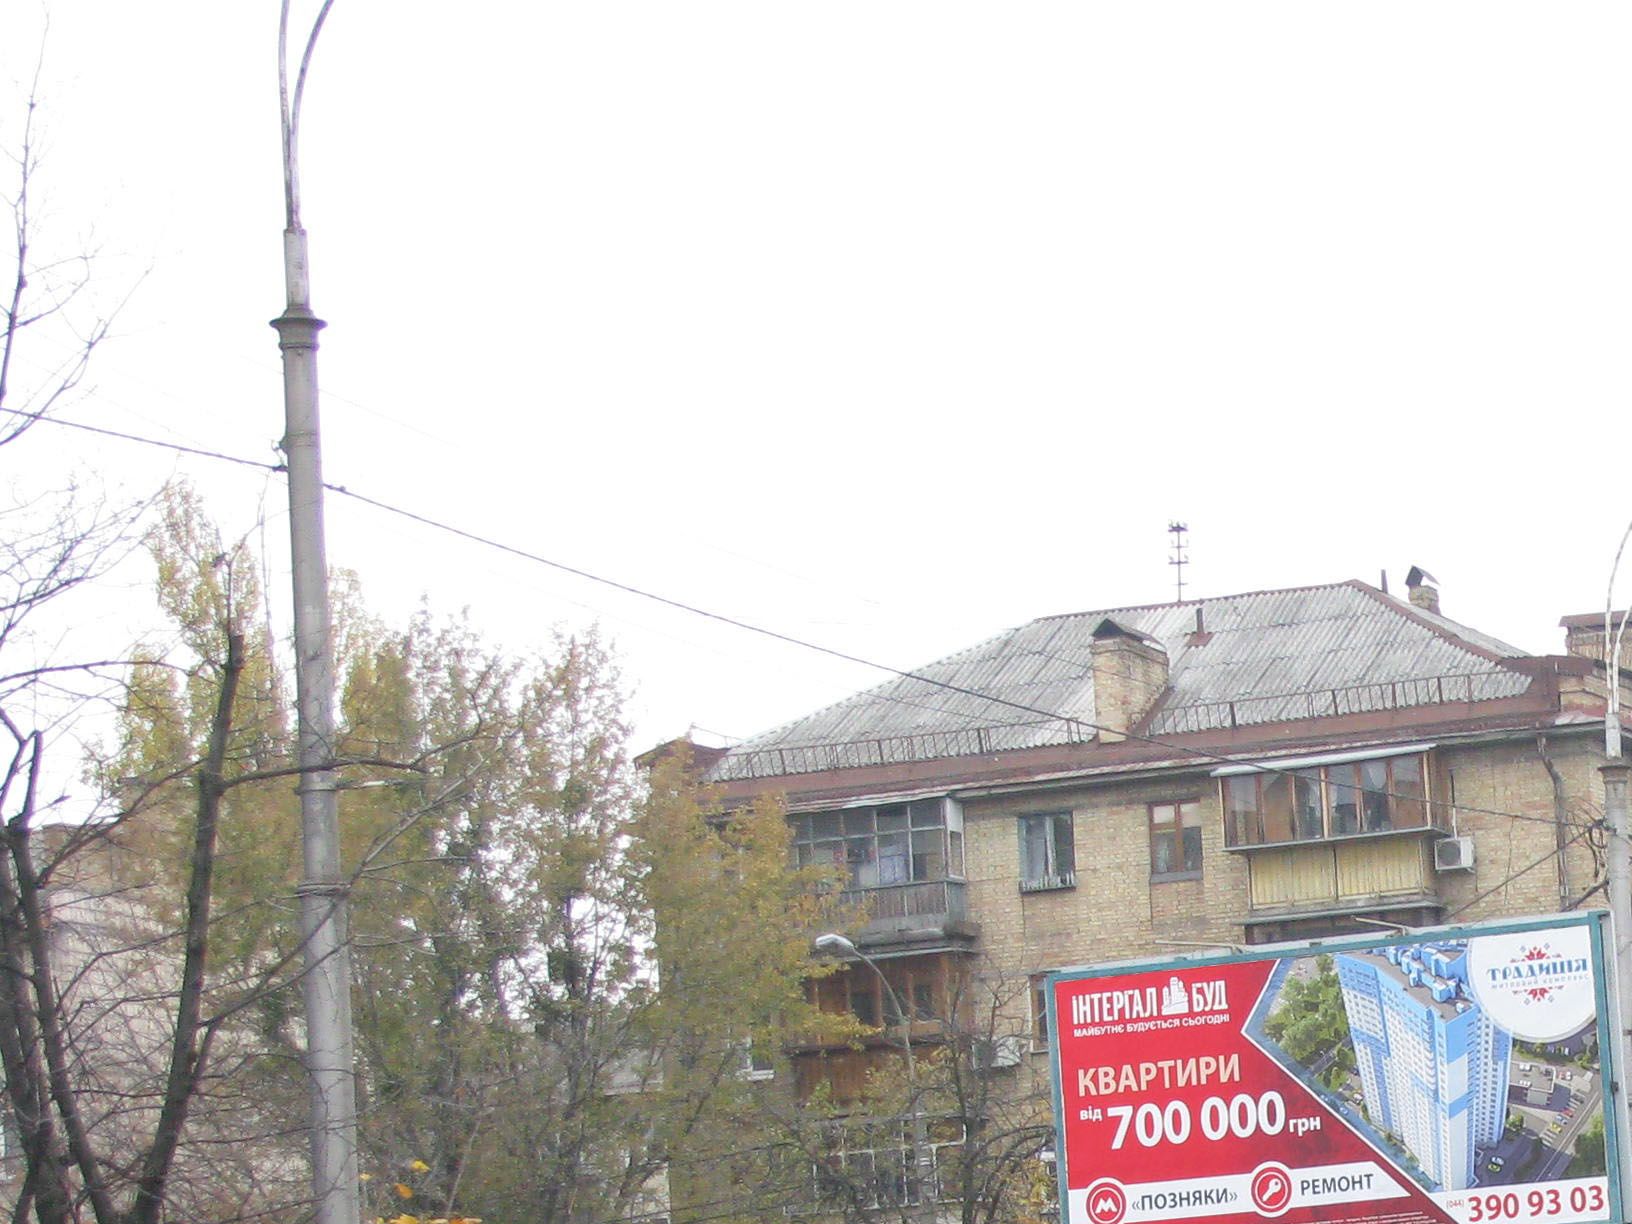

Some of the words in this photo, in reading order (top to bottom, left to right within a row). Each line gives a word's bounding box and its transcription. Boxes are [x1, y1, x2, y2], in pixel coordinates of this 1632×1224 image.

[1486, 958, 1588, 981] ТРАДИЦІЯ
[1191, 980, 1229, 1013] БУД
[1073, 1024, 1125, 1038] МАЙБУТНЄ
[1126, 1017, 1181, 1032] БУДУЄТЬСЯ
[1181, 1013, 1230, 1027] СЬОГОДНІ
[1078, 1053, 1241, 1097] КВАРТИРИ
[1079, 1106, 1103, 1122] від
[1107, 1101, 1192, 1151] 700
[1200, 1090, 1286, 1142] 000
[1289, 1115, 1321, 1137] грн
[1131, 1187, 1239, 1212] «ПОЗНЯКИ»
[1300, 1173, 1375, 1197] РЕМОНТ
[1468, 1192, 1520, 1223] 390
[1528, 1188, 1562, 1216] 93
[1569, 1184, 1605, 1212] 03
